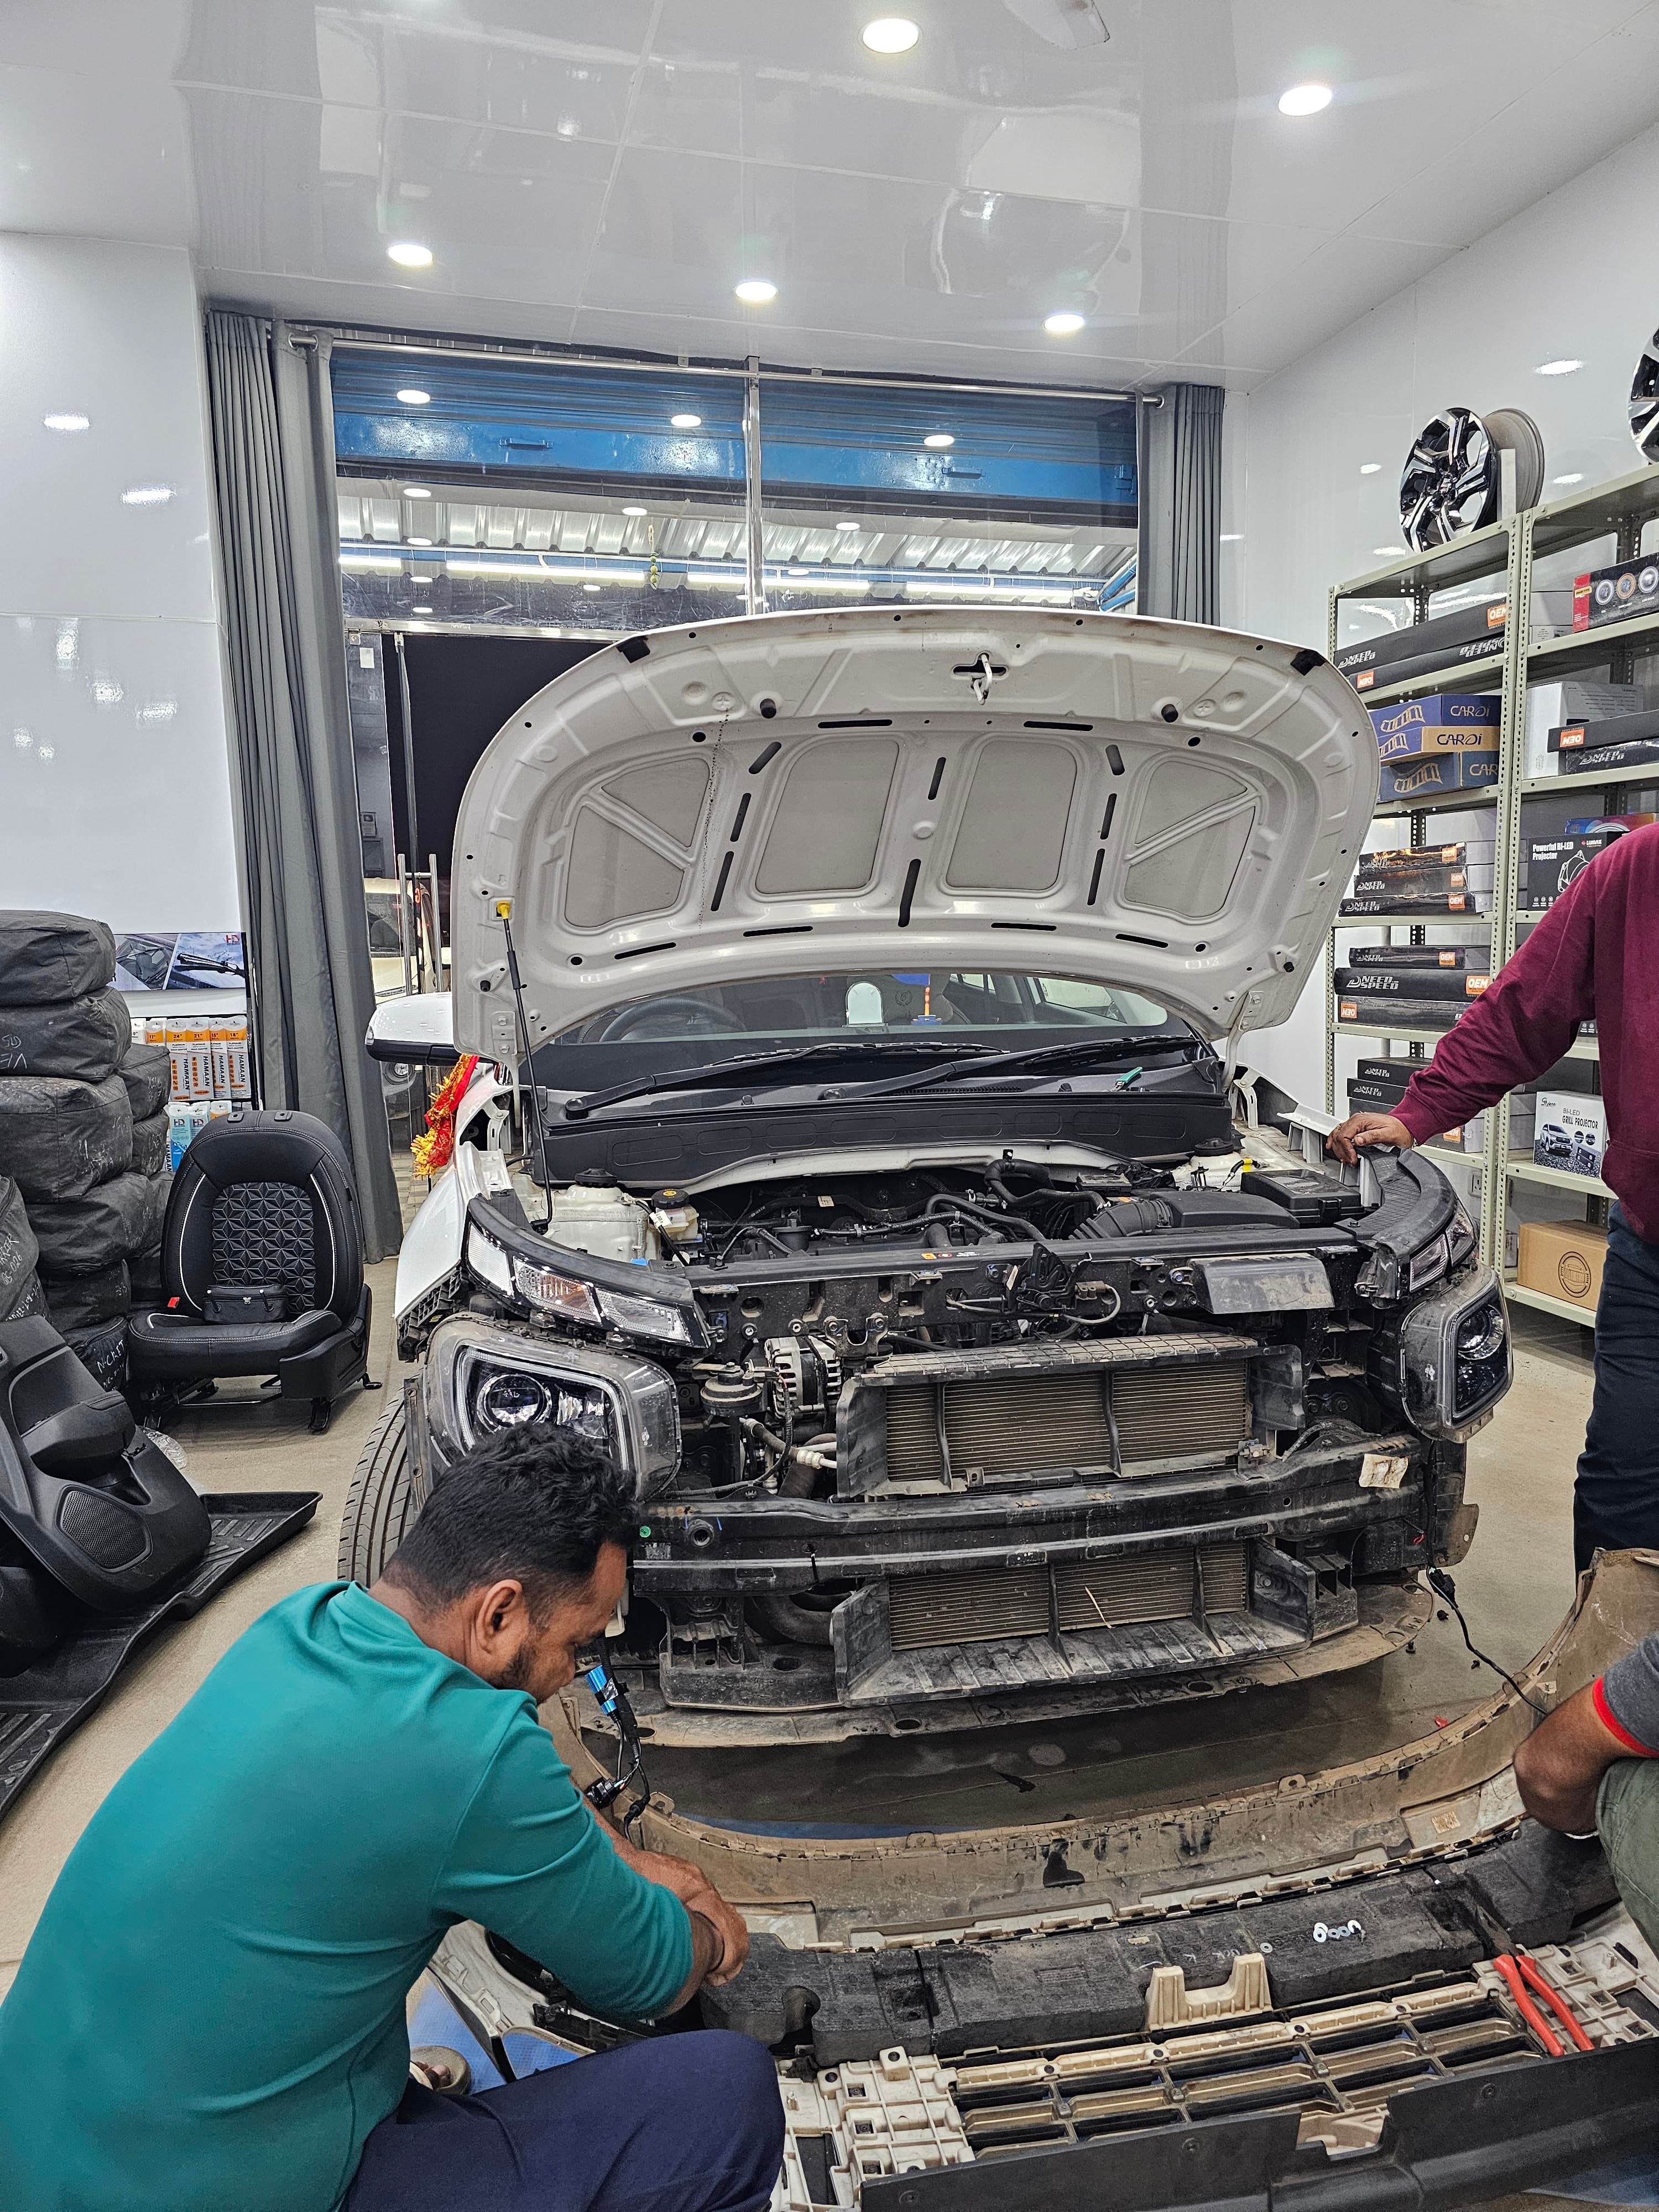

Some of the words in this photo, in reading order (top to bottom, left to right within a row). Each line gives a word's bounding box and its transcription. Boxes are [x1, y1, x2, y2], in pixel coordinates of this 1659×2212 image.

[1349, 650, 1371, 662] NEED
[1562, 735, 1582, 745] OEM
[1532, 843, 1557, 852] Powerful
[1532, 852, 1558, 861] Projector
[1468, 978, 1489, 988] OEM
[1563, 1108, 1580, 1116] BI-LED
[1562, 1115, 1573, 1125] GRILL
[1574, 1117, 1598, 1129] PROJECTOR
